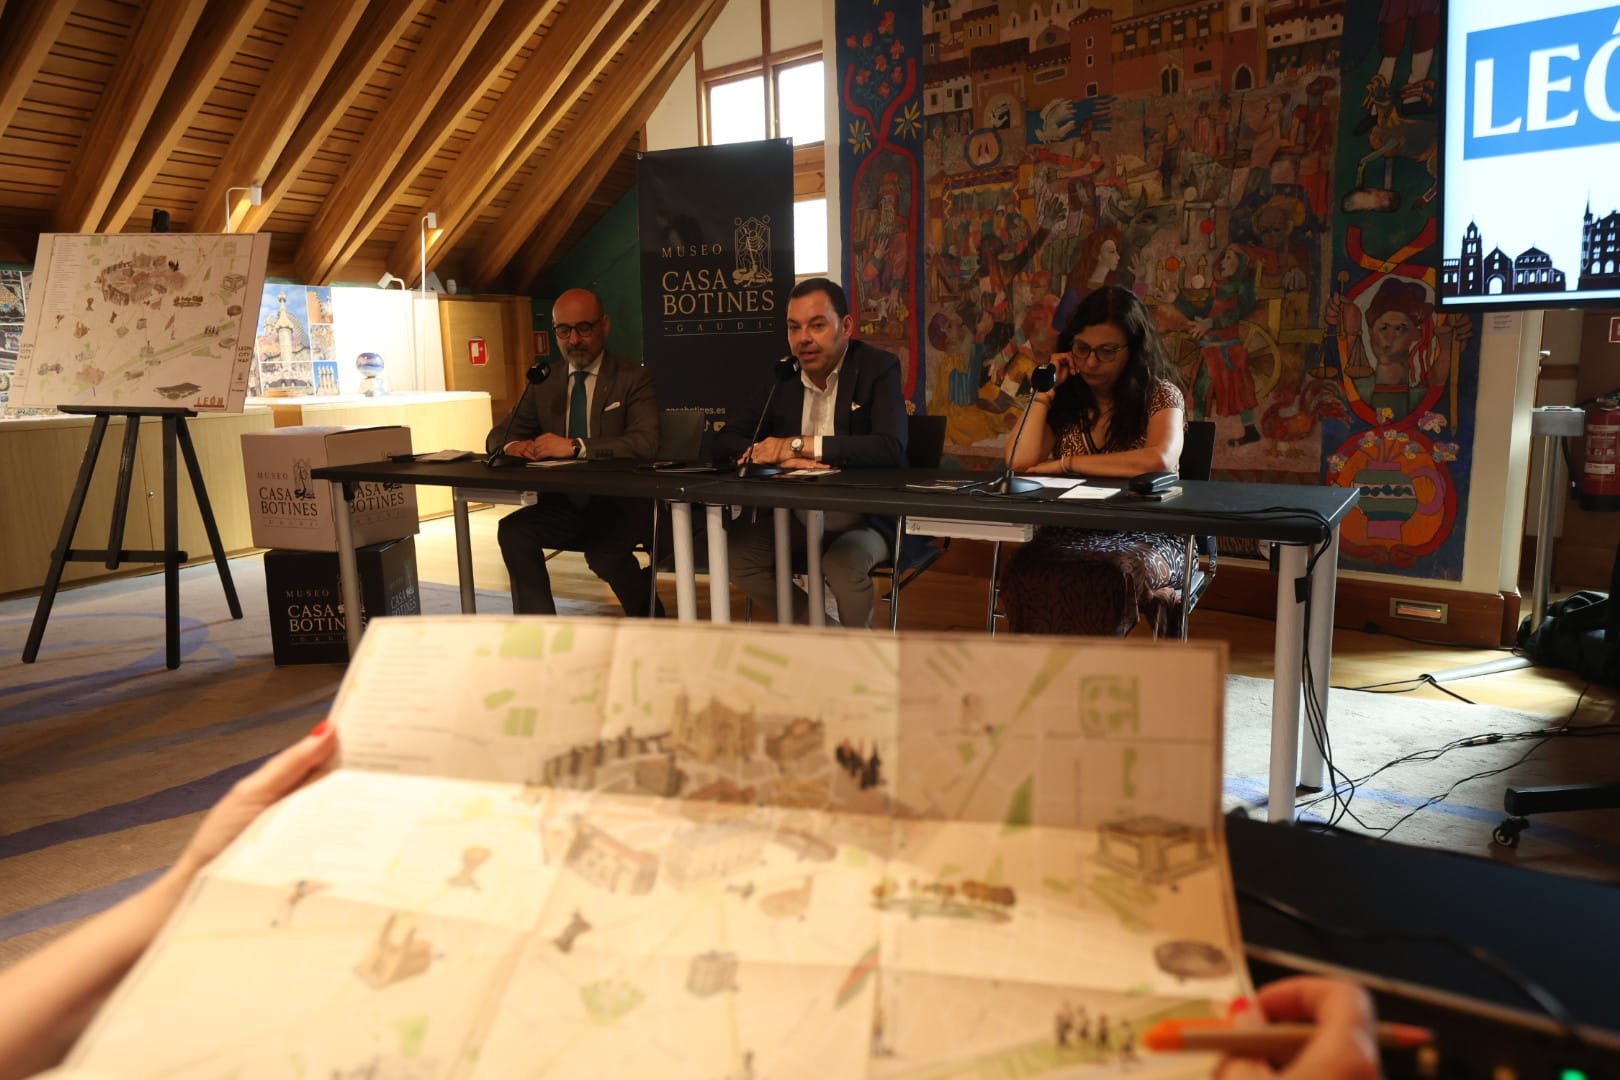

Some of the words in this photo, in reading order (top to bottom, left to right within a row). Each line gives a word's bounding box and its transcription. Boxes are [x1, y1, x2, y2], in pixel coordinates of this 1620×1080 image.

[661, 243, 723, 258] MUSEO
[661, 268, 729, 292] CASA
[662, 289, 776, 315] BOTINES
[256, 471, 289, 481] MUSEO
[259, 486, 293, 501] CASA
[357, 483, 382, 498] ASA
[260, 501, 318, 517] BOTINES
[286, 589, 330, 599] MUSEO
[287, 603, 335, 618] CASA
[289, 616, 368, 633] BOTINS
